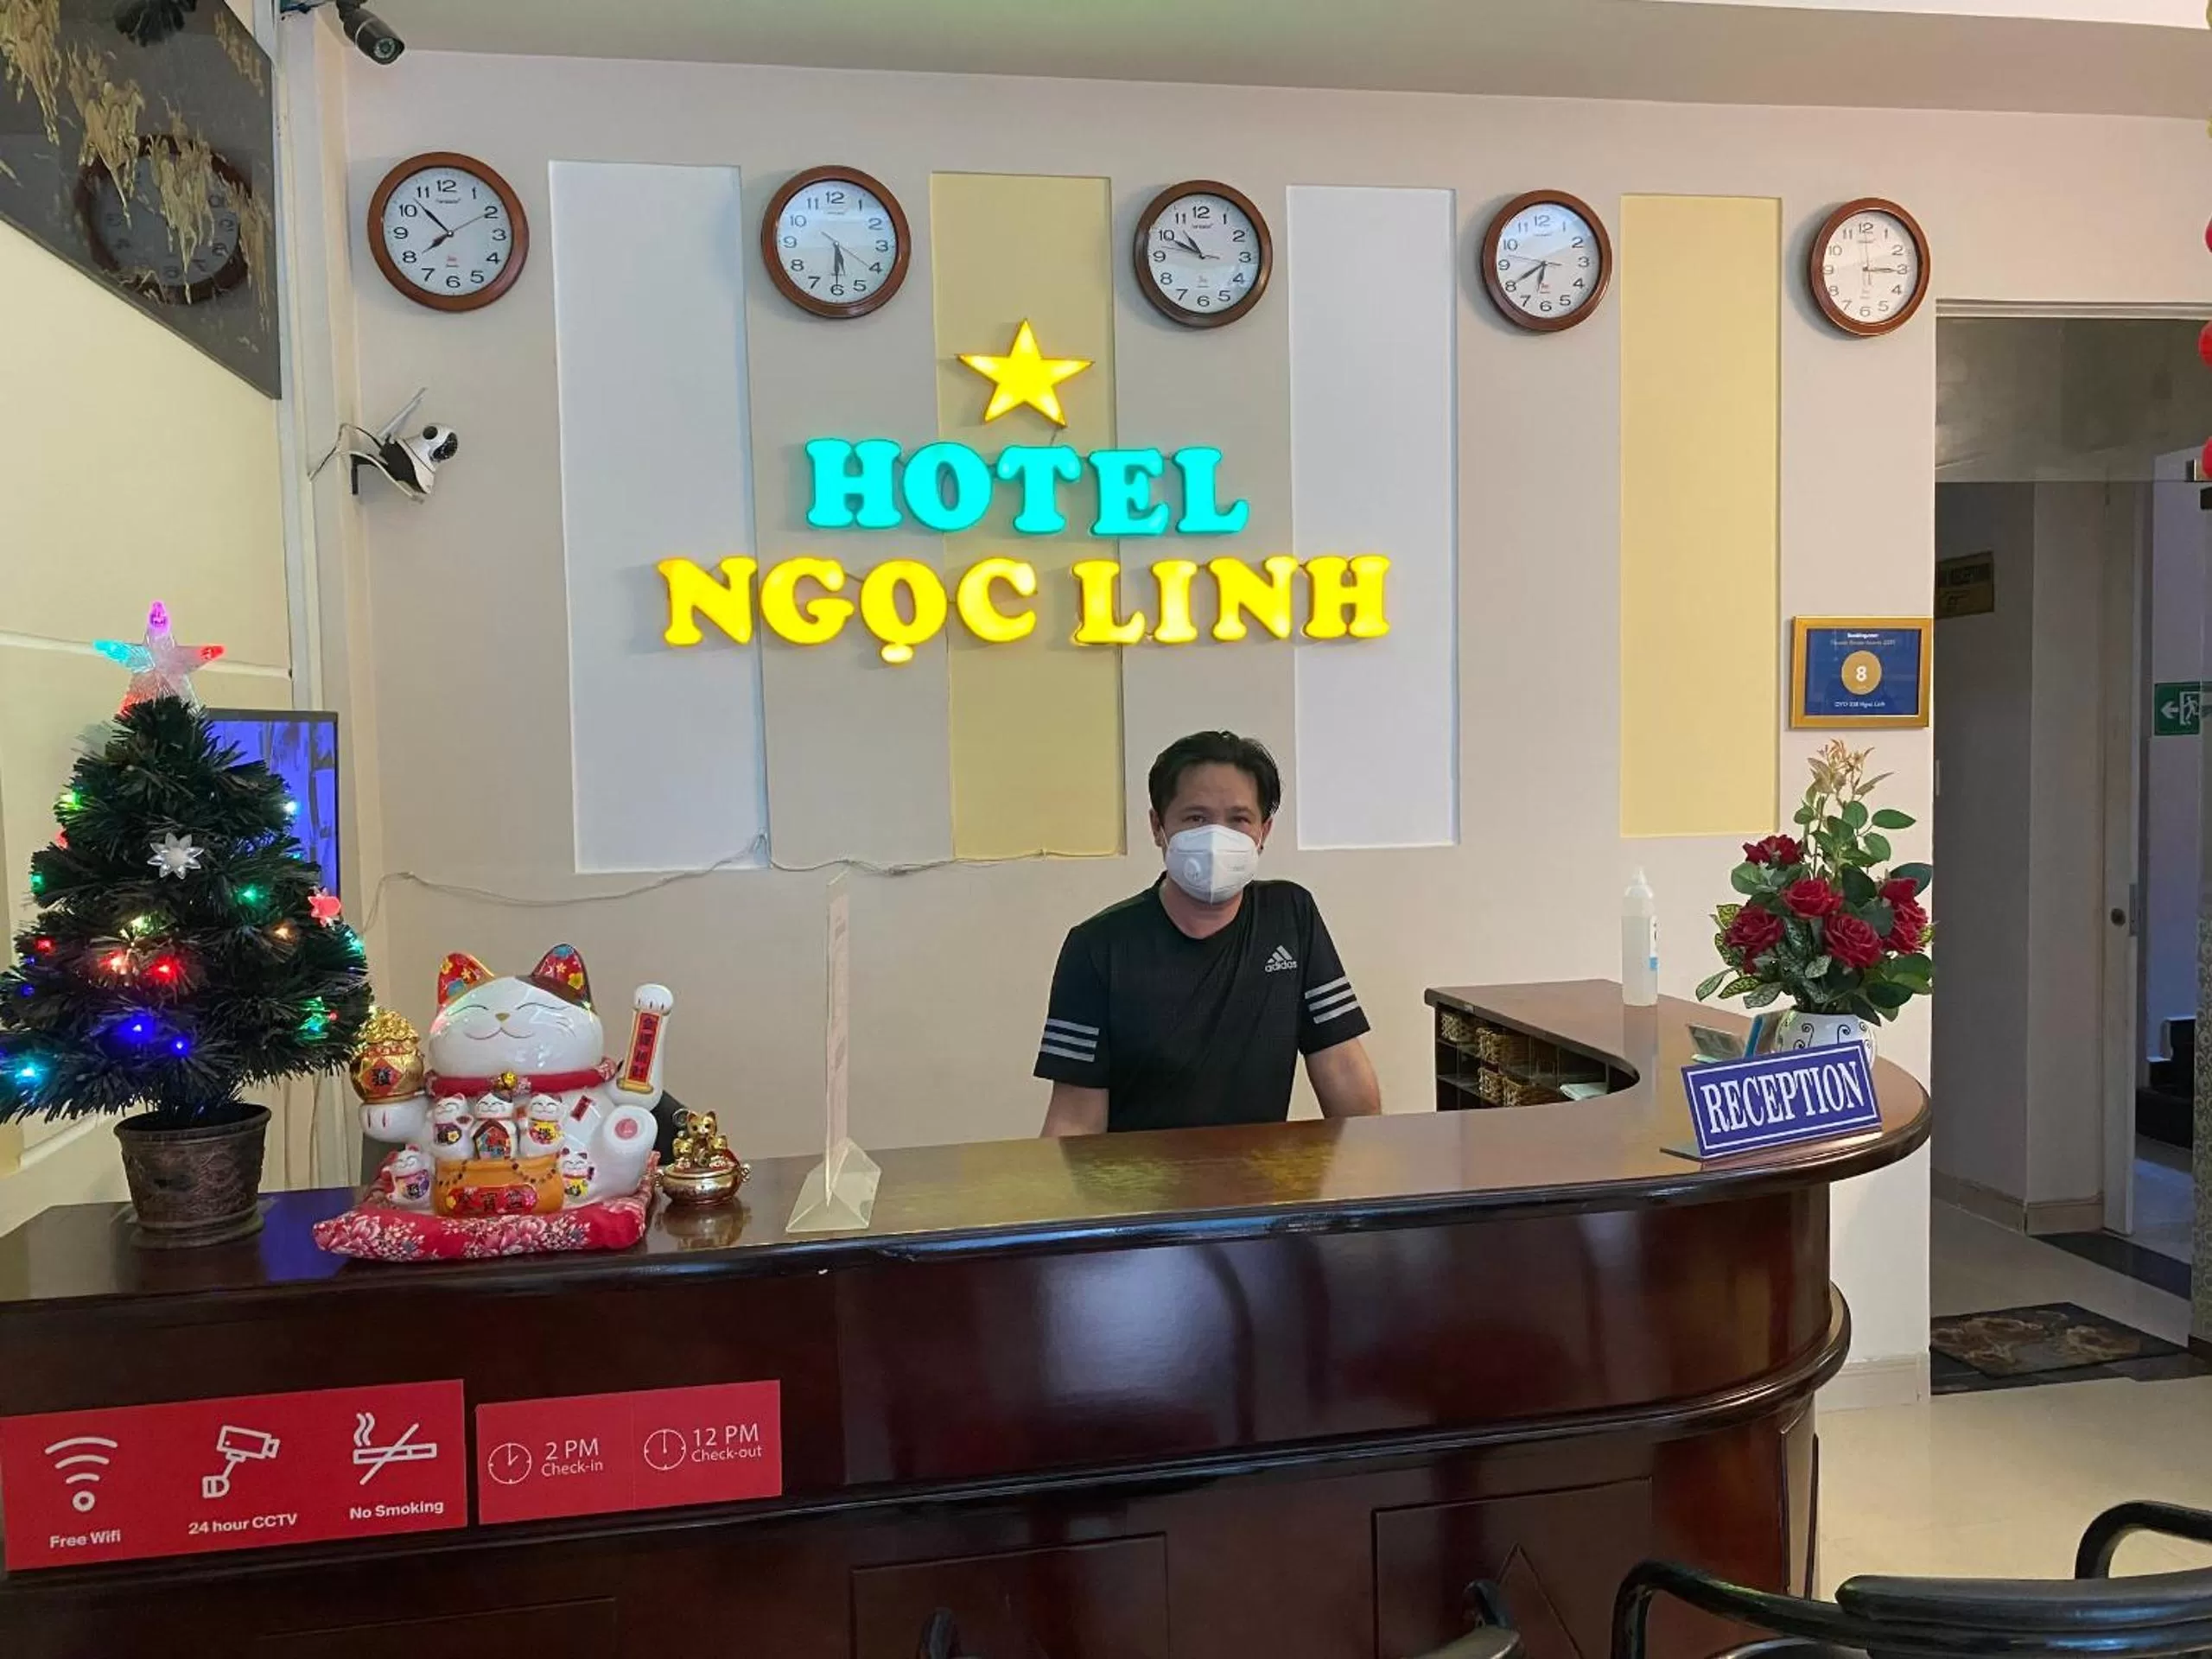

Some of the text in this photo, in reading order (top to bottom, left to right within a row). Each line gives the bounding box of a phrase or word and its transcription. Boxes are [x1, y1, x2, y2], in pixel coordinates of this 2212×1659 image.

[416, 187, 429, 198] 11
[436, 180, 457, 193] 12
[472, 187, 477, 200] 1
[826, 192, 845, 204] 12
[807, 198, 819, 210] 11
[858, 199, 862, 211] 1
[399, 205, 417, 217] 10
[485, 206, 498, 219] 2
[1192, 207, 1210, 219] 12
[790, 215, 807, 227] 10
[1175, 213, 1186, 224] 11
[1223, 214, 1227, 224] 1
[1535, 215, 1550, 226] 12
[868, 219, 882, 231] 2
[1518, 223, 1528, 232] 11
[1562, 222, 1566, 232] 1
[1859, 222, 1873, 233] 12
[394, 226, 408, 239] 9
[493, 229, 506, 241] 3
[1159, 230, 1174, 241] 10
[1233, 230, 1245, 242] 2
[1843, 229, 1853, 239] 11
[1885, 228, 1888, 238] 1
[784, 236, 797, 248] 9
[875, 240, 888, 251] 3
[1503, 238, 1518, 251] 10
[1572, 238, 1583, 248] 2
[1154, 251, 1166, 262] 9
[1828, 245, 1842, 256] 10
[1892, 245, 1904, 256] 2
[403, 251, 416, 263] 8
[486, 252, 500, 264] 4
[1239, 251, 1251, 263] 3
[1579, 257, 1589, 268] 3
[791, 259, 804, 271] 8
[869, 262, 881, 274] 4
[1498, 259, 1510, 270] 9
[1824, 265, 1834, 275] 9
[1897, 264, 1907, 275] 3
[422, 268, 435, 282] 7
[471, 270, 484, 283] 5
[1160, 273, 1173, 284] 8
[1233, 273, 1244, 284] 4
[446, 276, 461, 288] 6
[808, 276, 820, 289] 7
[853, 280, 866, 292] 5
[1505, 282, 1516, 292] 8
[1573, 277, 1585, 289] 4
[830, 284, 844, 296] 6
[1176, 289, 1188, 301] 7
[1828, 286, 1839, 296] 8
[1891, 284, 1901, 295] 4
[1197, 296, 1210, 307] 6
[1218, 290, 1230, 302] 5
[1521, 295, 1531, 307] 7
[1560, 295, 1571, 306] 5
[1540, 301, 1552, 311] 6
[1842, 300, 1853, 311] 7
[1878, 301, 1889, 311] 5
[1859, 307, 1871, 317] 6
[804, 438, 1249, 537] HOTEL
[657, 555, 1392, 665] NGỌC LINH
[1856, 665, 1867, 682] 8
[1265, 960, 1297, 972] adidas
[1700, 1062, 1865, 1134] RECEPTION
[694, 1424, 759, 1446] 12 PM
[545, 1438, 599, 1460] 2 PM
[691, 1445, 763, 1463] Check-out
[541, 1460, 603, 1477] Check-in
[350, 1499, 443, 1519] No Smoking
[188, 1513, 298, 1535] 24 hour CCTV
[49, 1529, 121, 1549] Free Wifi
